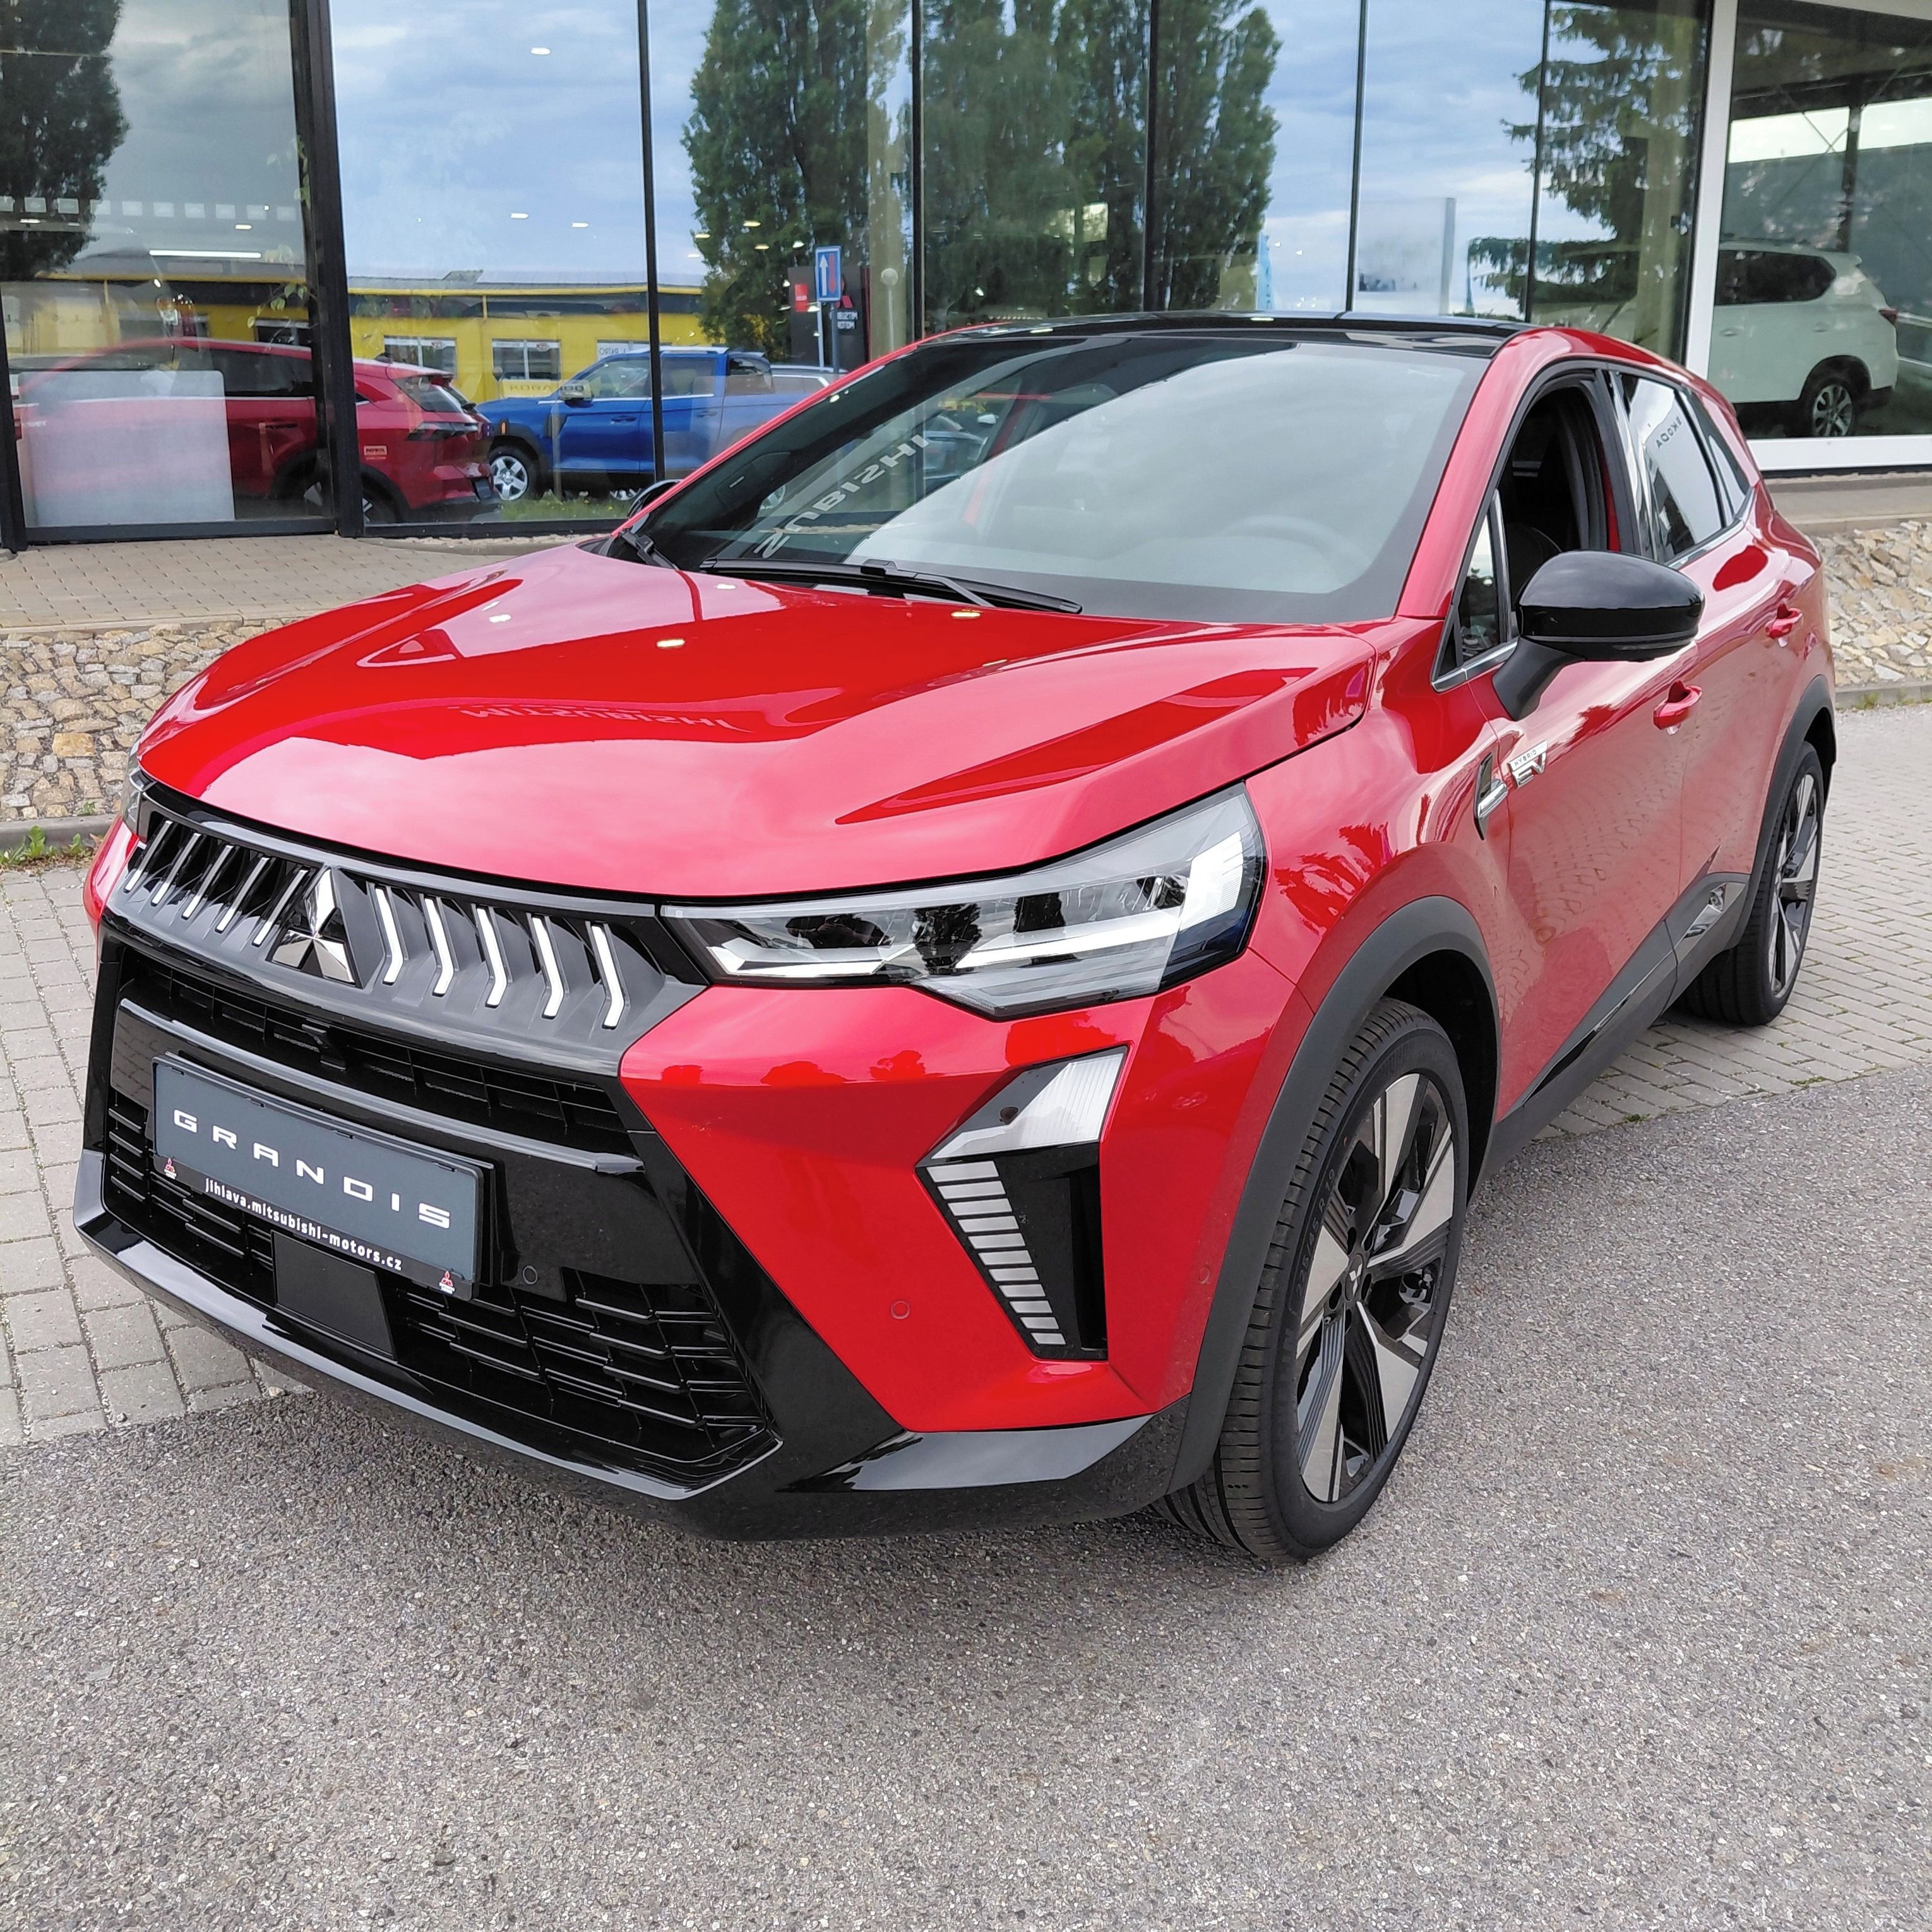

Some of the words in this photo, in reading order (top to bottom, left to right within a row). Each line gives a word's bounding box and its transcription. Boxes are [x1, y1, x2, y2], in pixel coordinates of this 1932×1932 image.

[1514, 749, 1537, 767] HYBRID
[173, 1109, 453, 1230] GRANDIS
[205, 1178, 403, 1271] jihlava.mitsubishi-motors.cz
